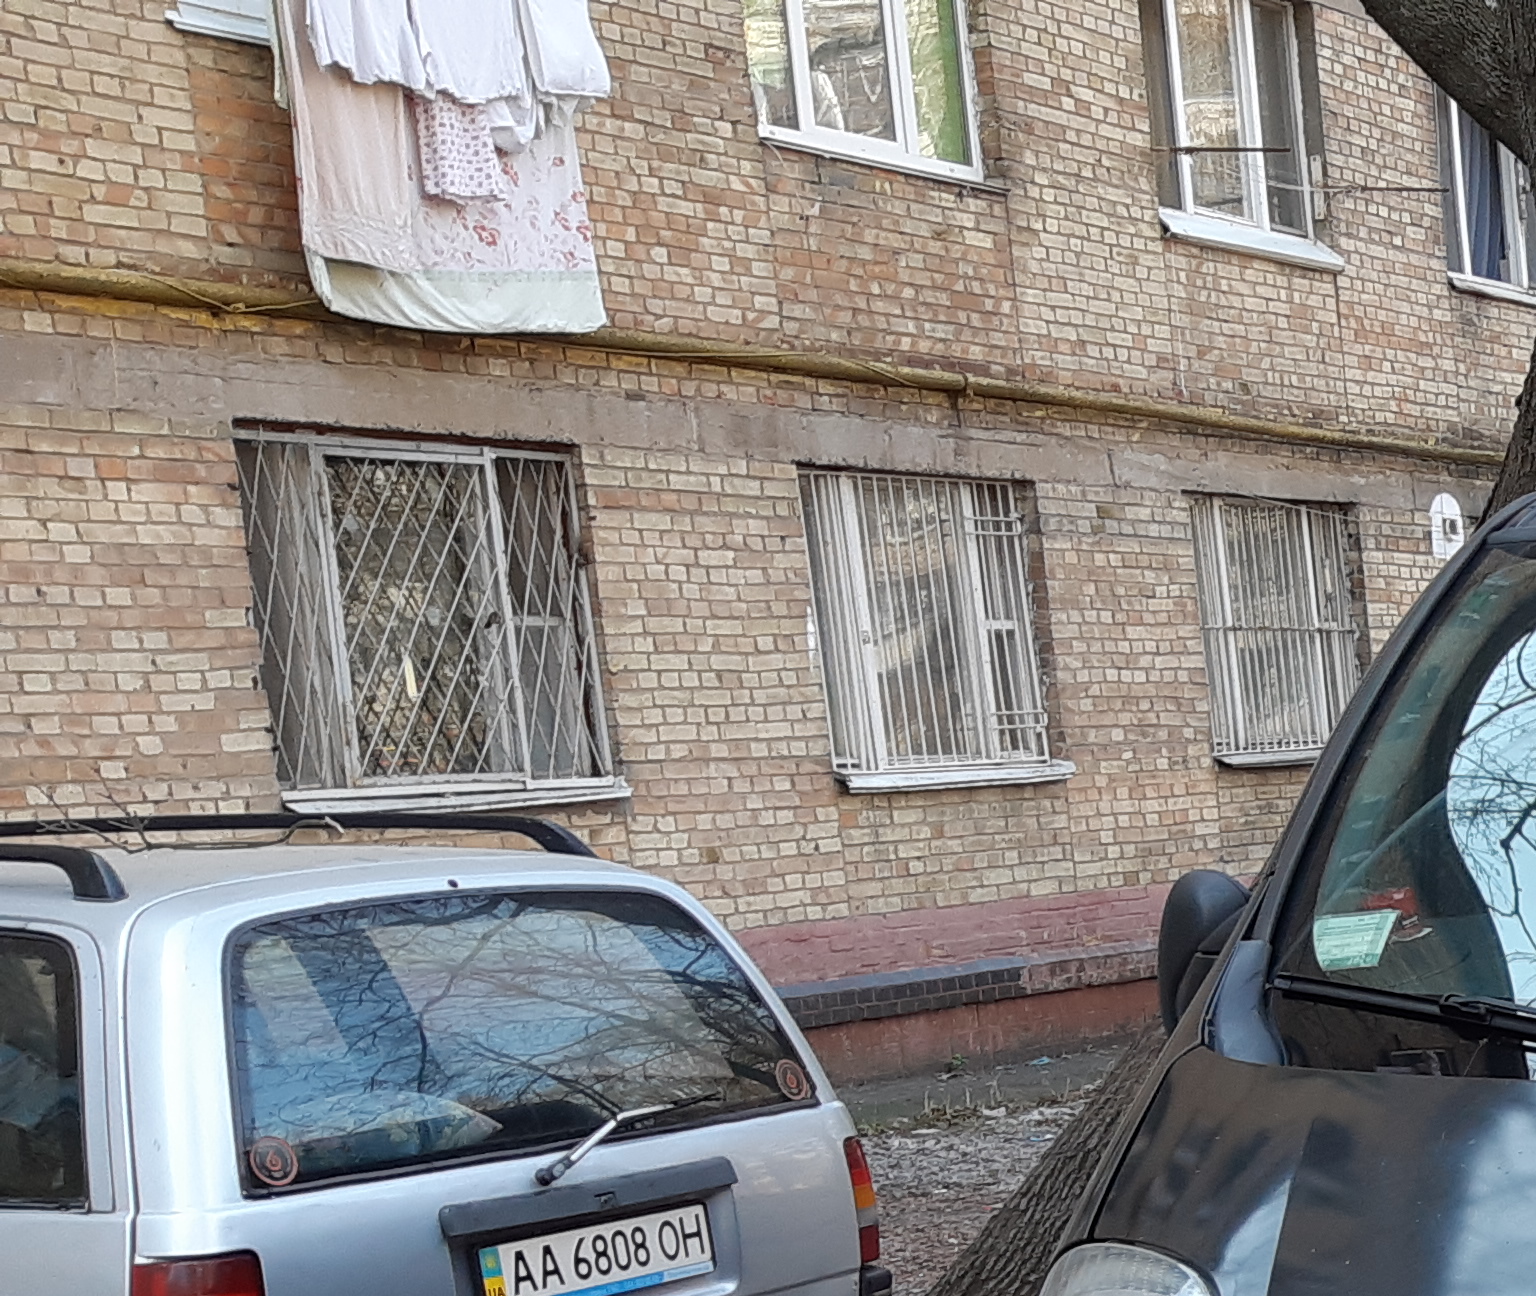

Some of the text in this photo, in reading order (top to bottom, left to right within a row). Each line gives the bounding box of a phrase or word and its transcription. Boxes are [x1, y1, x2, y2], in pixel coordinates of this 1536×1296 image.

[514, 1245, 565, 1296] AA
[573, 1226, 650, 1280] 6808
[658, 1213, 706, 1261] OH
